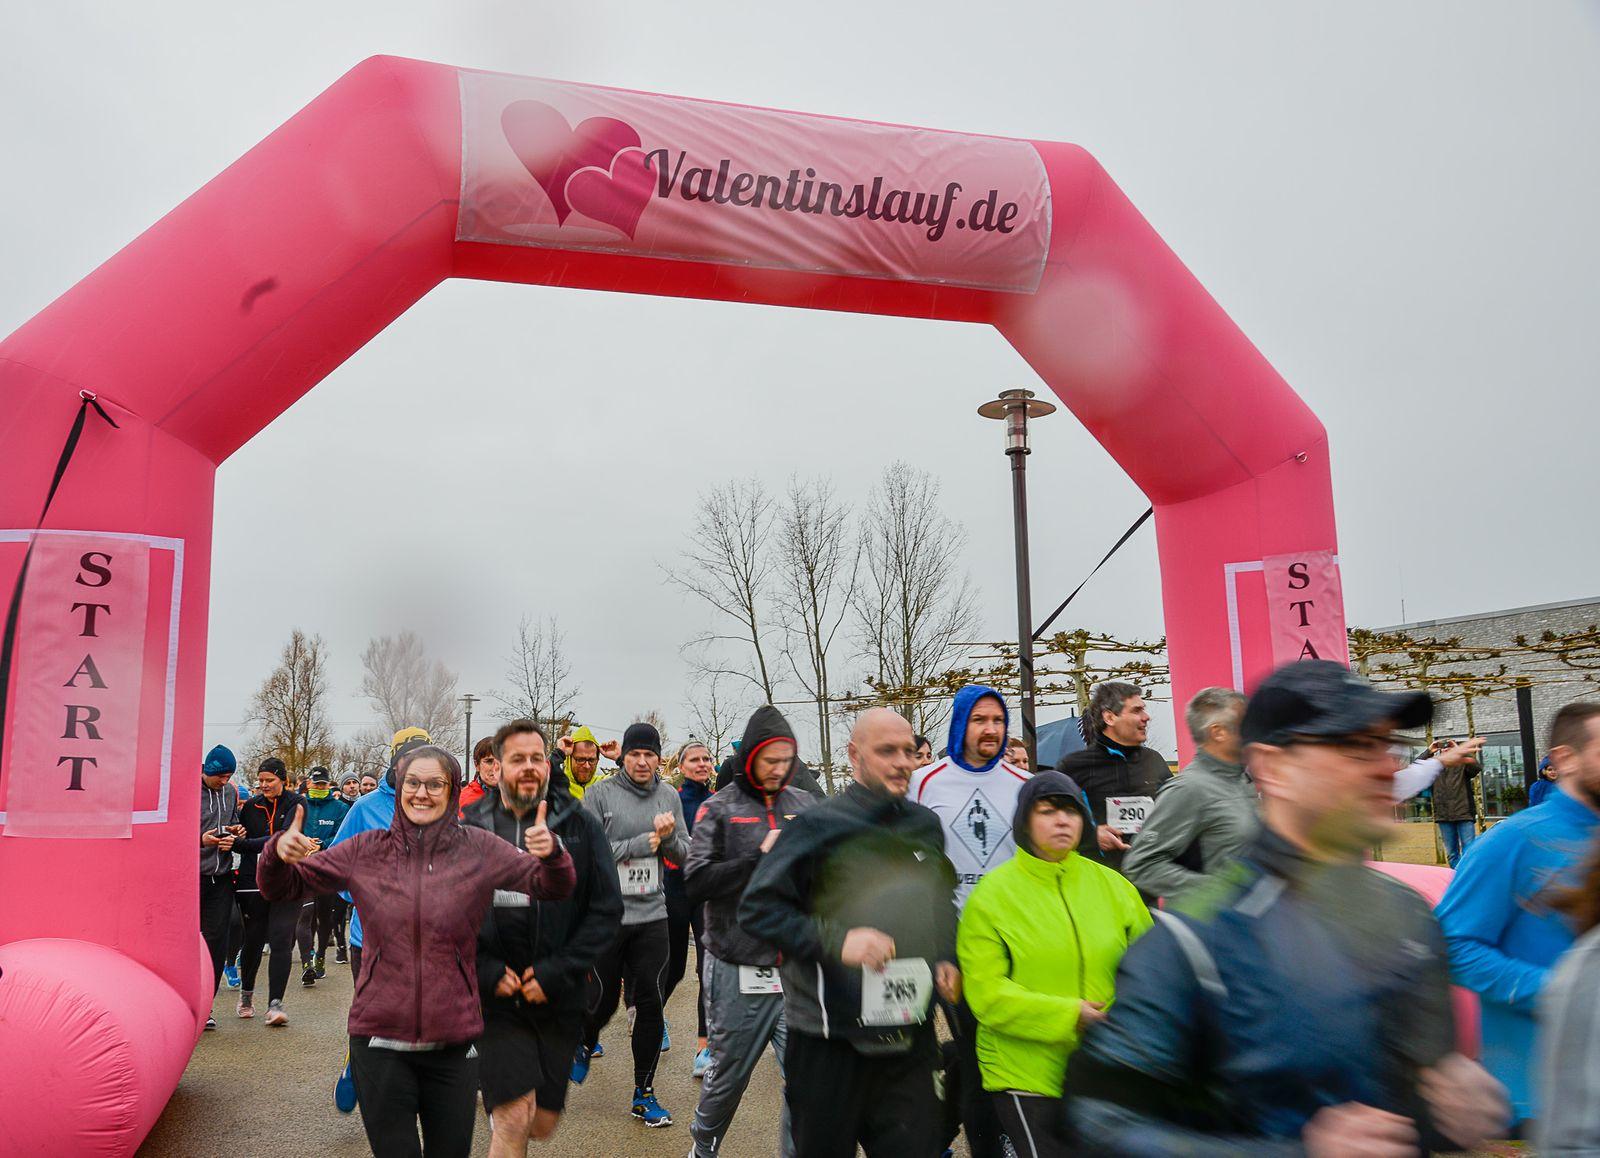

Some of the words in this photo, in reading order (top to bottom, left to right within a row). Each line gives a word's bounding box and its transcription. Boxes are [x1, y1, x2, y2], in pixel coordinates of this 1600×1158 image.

[643, 149, 1019, 242] Valentinslauf.de
[1287, 562, 1321, 661] STA
[56, 551, 113, 792] START
[1119, 807, 1145, 821] 290
